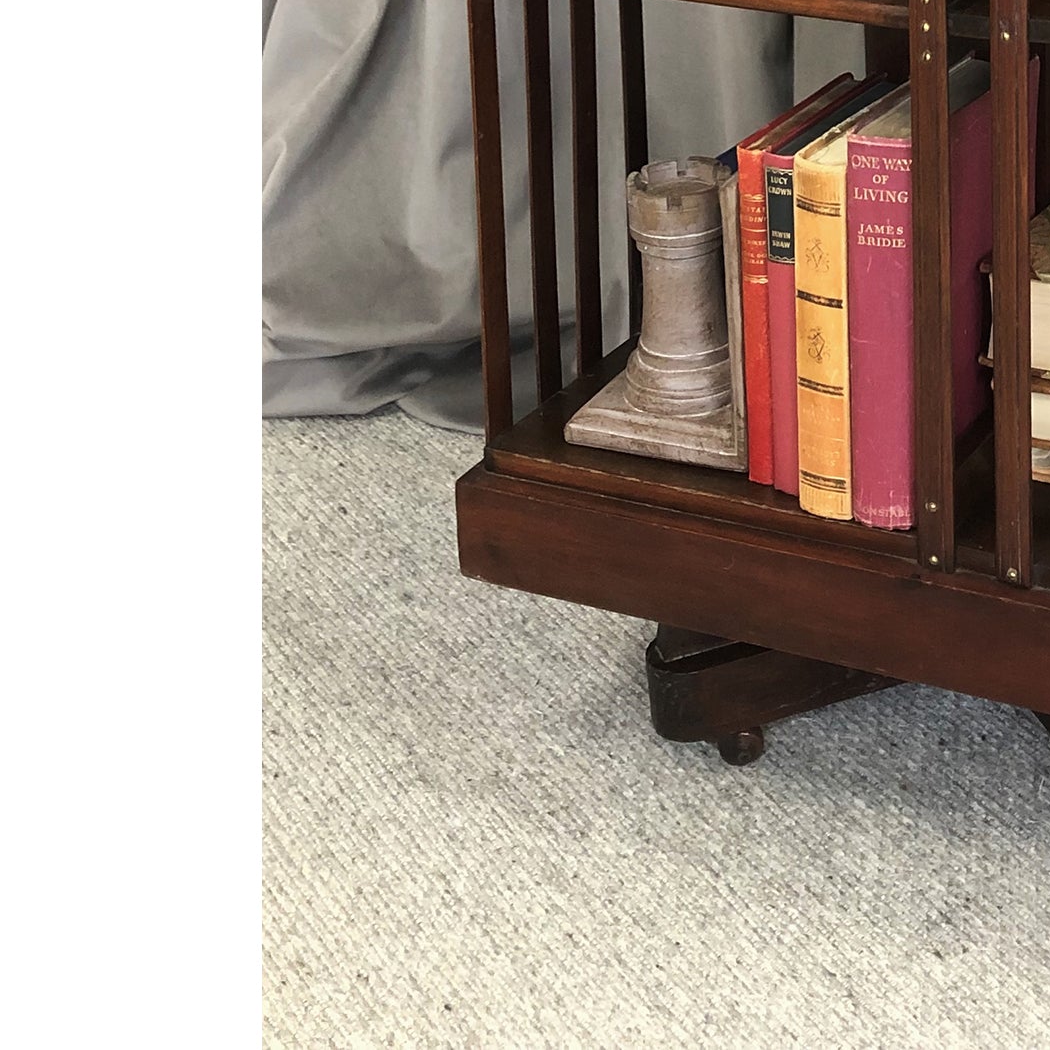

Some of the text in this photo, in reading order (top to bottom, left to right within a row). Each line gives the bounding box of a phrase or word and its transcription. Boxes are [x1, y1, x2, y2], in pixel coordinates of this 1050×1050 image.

[851, 154, 912, 171] ONE WAY
[770, 176, 788, 185] LUCY
[872, 174, 889, 185] OF
[768, 187, 792, 196] CROWN
[854, 187, 909, 203] LIVING
[858, 223, 904, 235] JAMES
[772, 239, 790, 249] SHAW
[857, 235, 907, 248] BRIDIE
